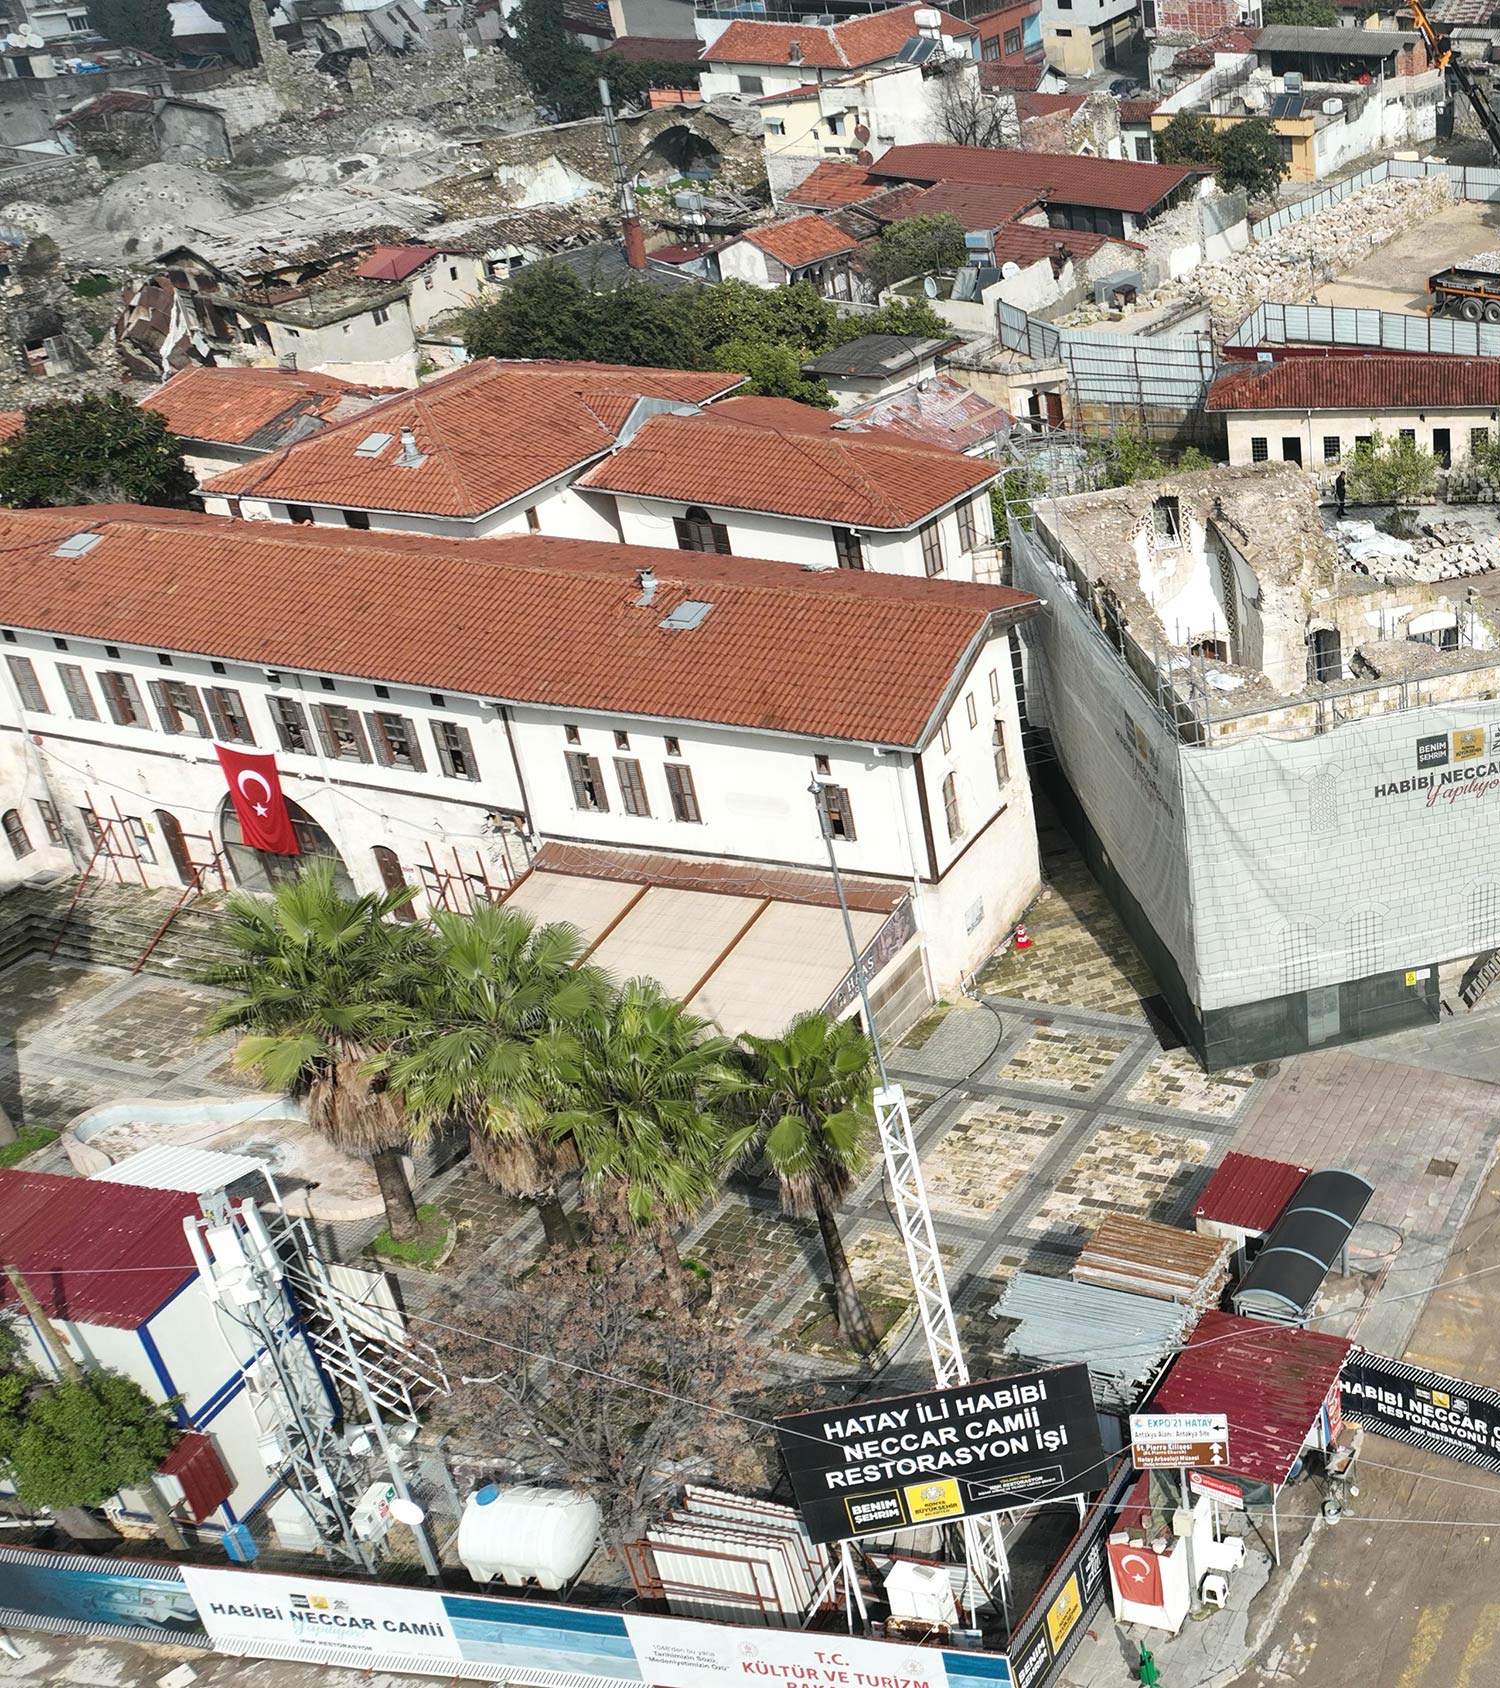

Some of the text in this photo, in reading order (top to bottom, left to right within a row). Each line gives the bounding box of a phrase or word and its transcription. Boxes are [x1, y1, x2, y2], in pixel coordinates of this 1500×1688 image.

[1418, 741, 1447, 755] BENİM
[1419, 750, 1447, 764] ŞEHRİM
[1374, 772, 1434, 798] HABİBİ
[823, 1379, 1048, 1441] HATAY İLİ HABİBİ
[1340, 1379, 1403, 1408] HABİBİ
[1409, 1398, 1488, 1435] NECCAR
[843, 1406, 1041, 1463] NECCAR CAMİİ
[1135, 1431, 1157, 1439] Antakya
[1175, 1431, 1198, 1439] Antakya
[1184, 1418, 1213, 1427] HATAY
[1377, 1403, 1487, 1445] RESTORASYONU
[824, 1424, 1068, 1490] RESTORASYON İŞİ
[851, 1498, 898, 1516] BENİM
[854, 1507, 900, 1525] ŞEHRİM
[210, 1602, 445, 1638] HABİBİ NECCAR CAMİİ
[814, 1652, 849, 1666] T.C.
[1018, 1637, 1046, 1684] BENİM
[742, 1660, 930, 1688] KÜLTÜR VE TURİZM
